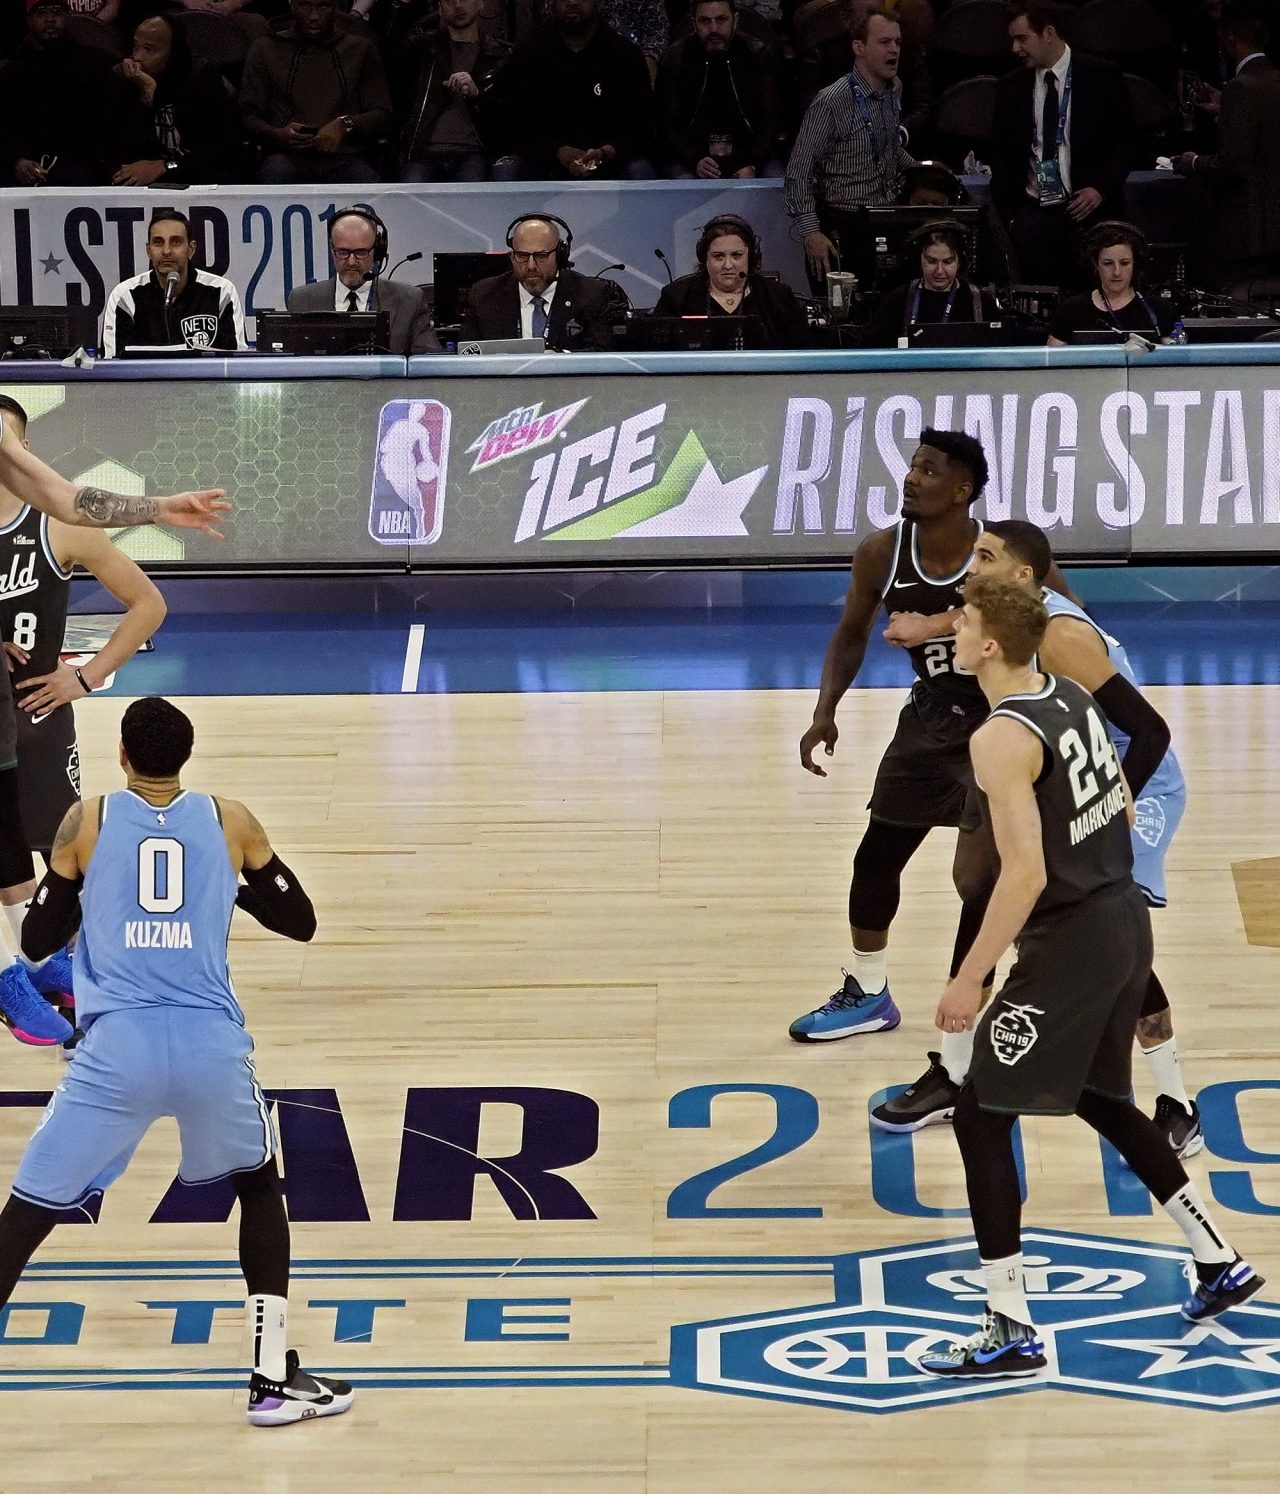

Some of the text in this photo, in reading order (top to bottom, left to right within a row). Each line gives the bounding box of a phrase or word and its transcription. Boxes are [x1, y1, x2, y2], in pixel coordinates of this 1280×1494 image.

[64, 206, 230, 326] STR
[242, 203, 376, 316] 201
[184, 317, 215, 334] NETS
[772, 392, 1078, 534] RISNG
[378, 510, 412, 534] NBA
[13, 612, 37, 651] 8
[924, 643, 972, 678] 2
[1059, 707, 1120, 809] 24
[137, 837, 185, 914] 0
[125, 921, 193, 949] KUZMA
[994, 1029, 1030, 1047] CHA 19
